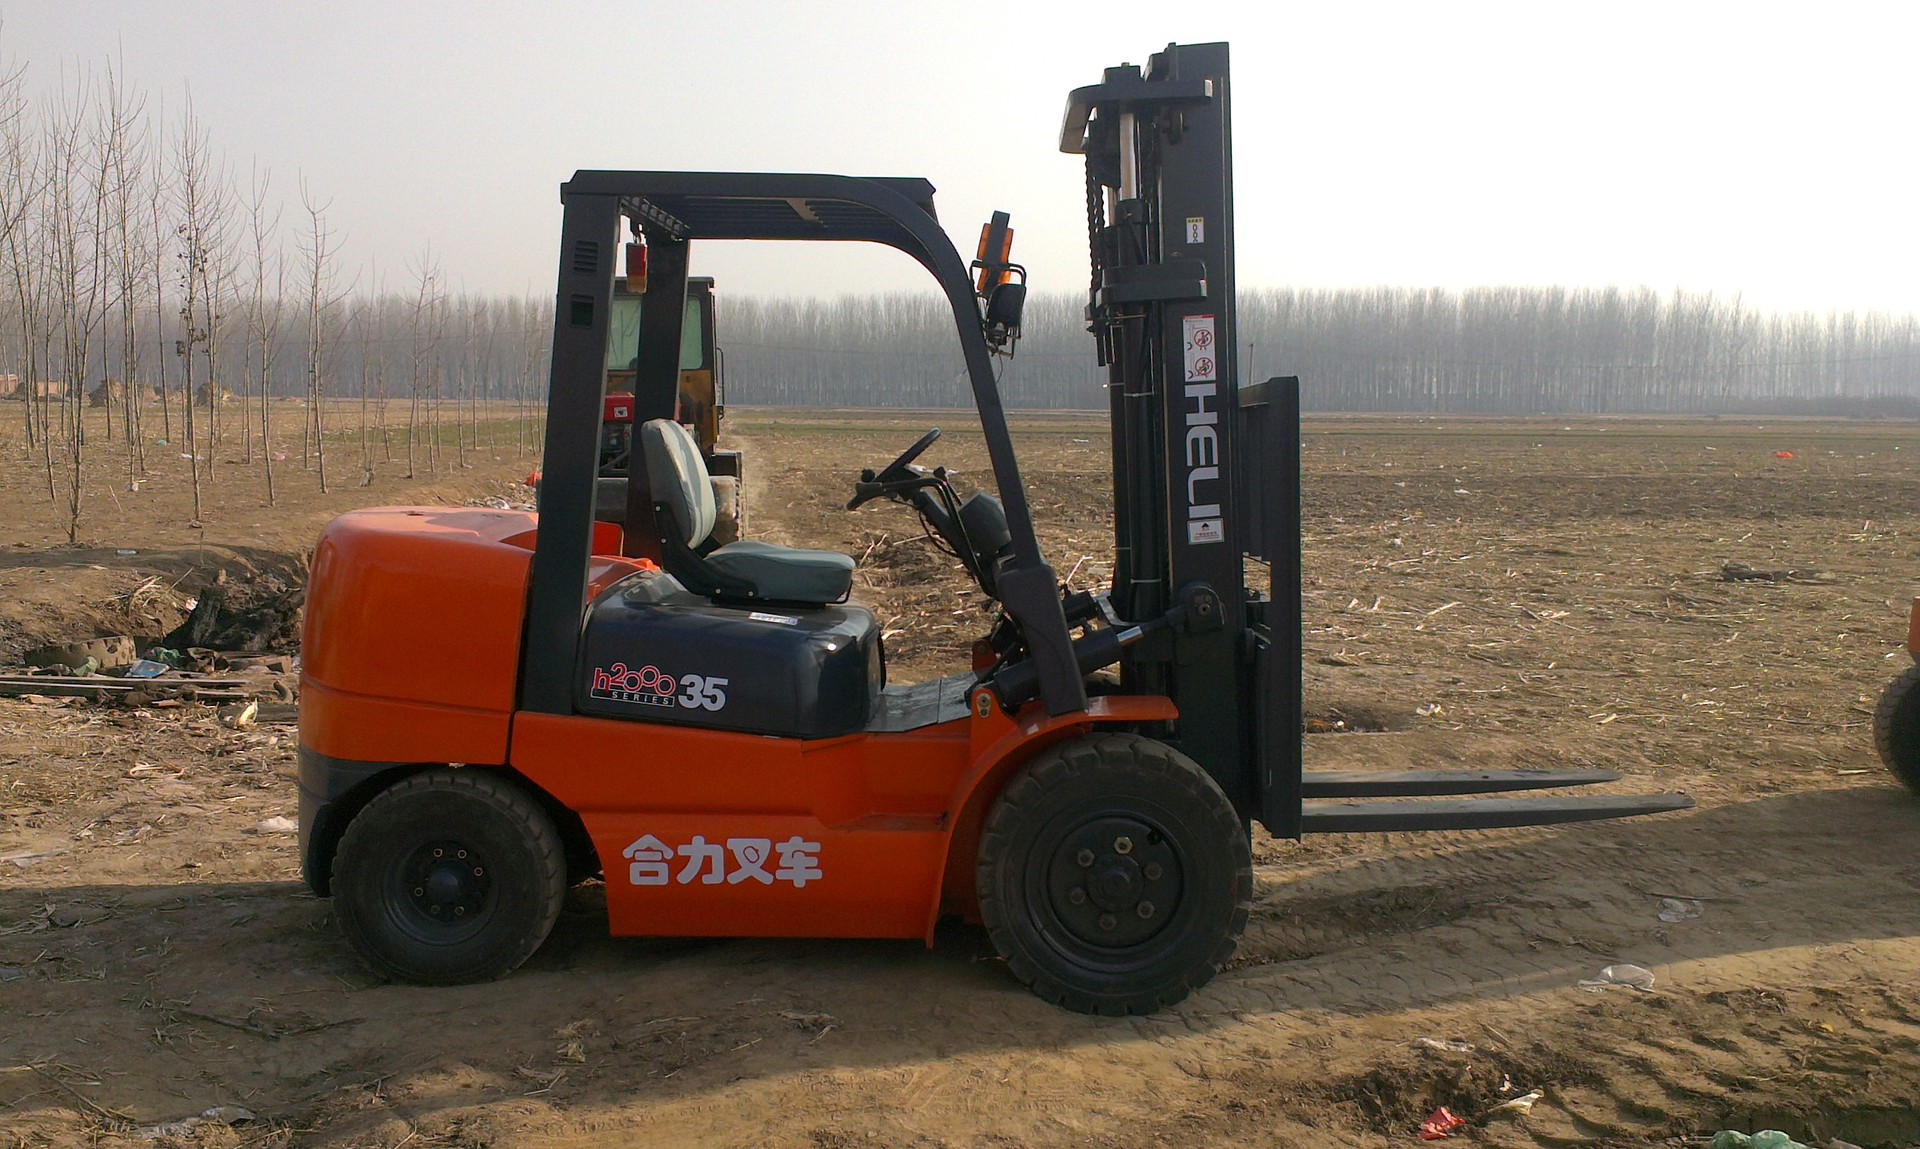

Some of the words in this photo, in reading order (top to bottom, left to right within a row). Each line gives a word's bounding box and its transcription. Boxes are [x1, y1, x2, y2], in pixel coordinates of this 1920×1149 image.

[1184, 383, 1221, 519] HELI
[593, 662, 677, 697] h2000
[677, 673, 729, 712] 35
[622, 833, 823, 888] 合力叉车
